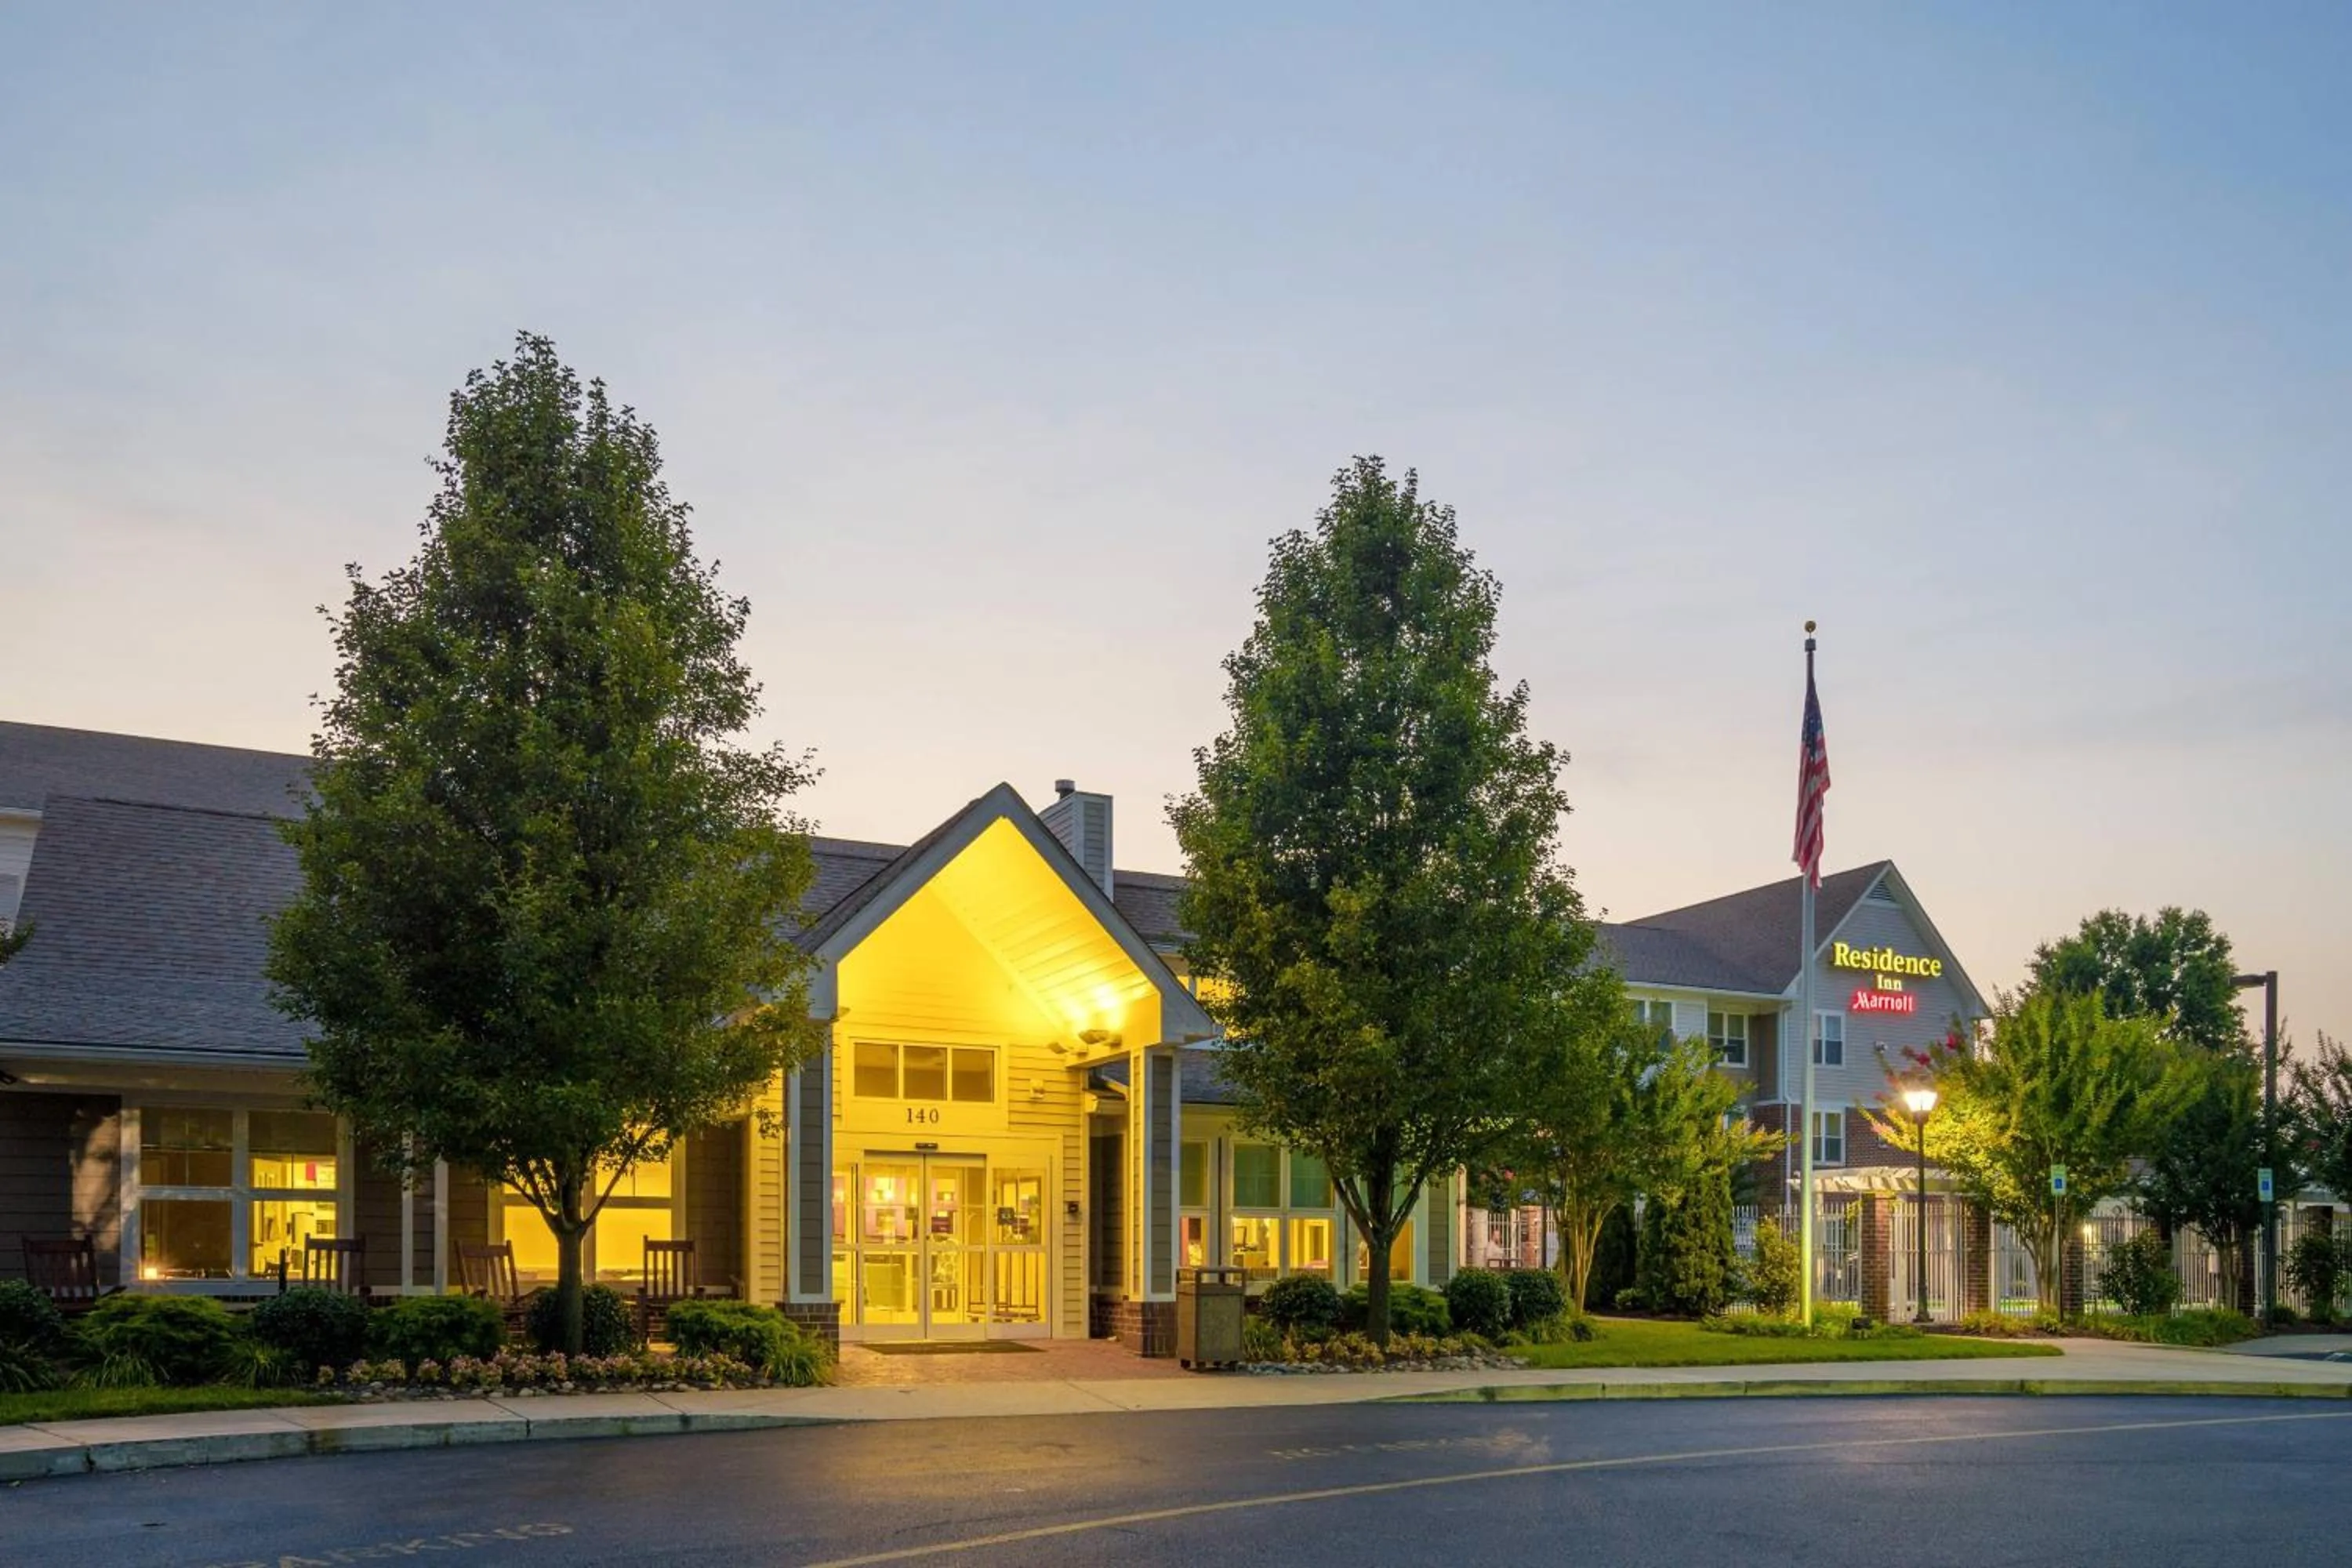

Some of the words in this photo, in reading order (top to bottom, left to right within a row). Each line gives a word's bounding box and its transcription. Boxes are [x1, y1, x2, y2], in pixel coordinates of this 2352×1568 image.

[1833, 942, 1942, 976] Residence
[1876, 974, 1903, 991] Inn
[1853, 990, 1913, 1011] Marriott
[906, 1107, 939, 1124] 140
